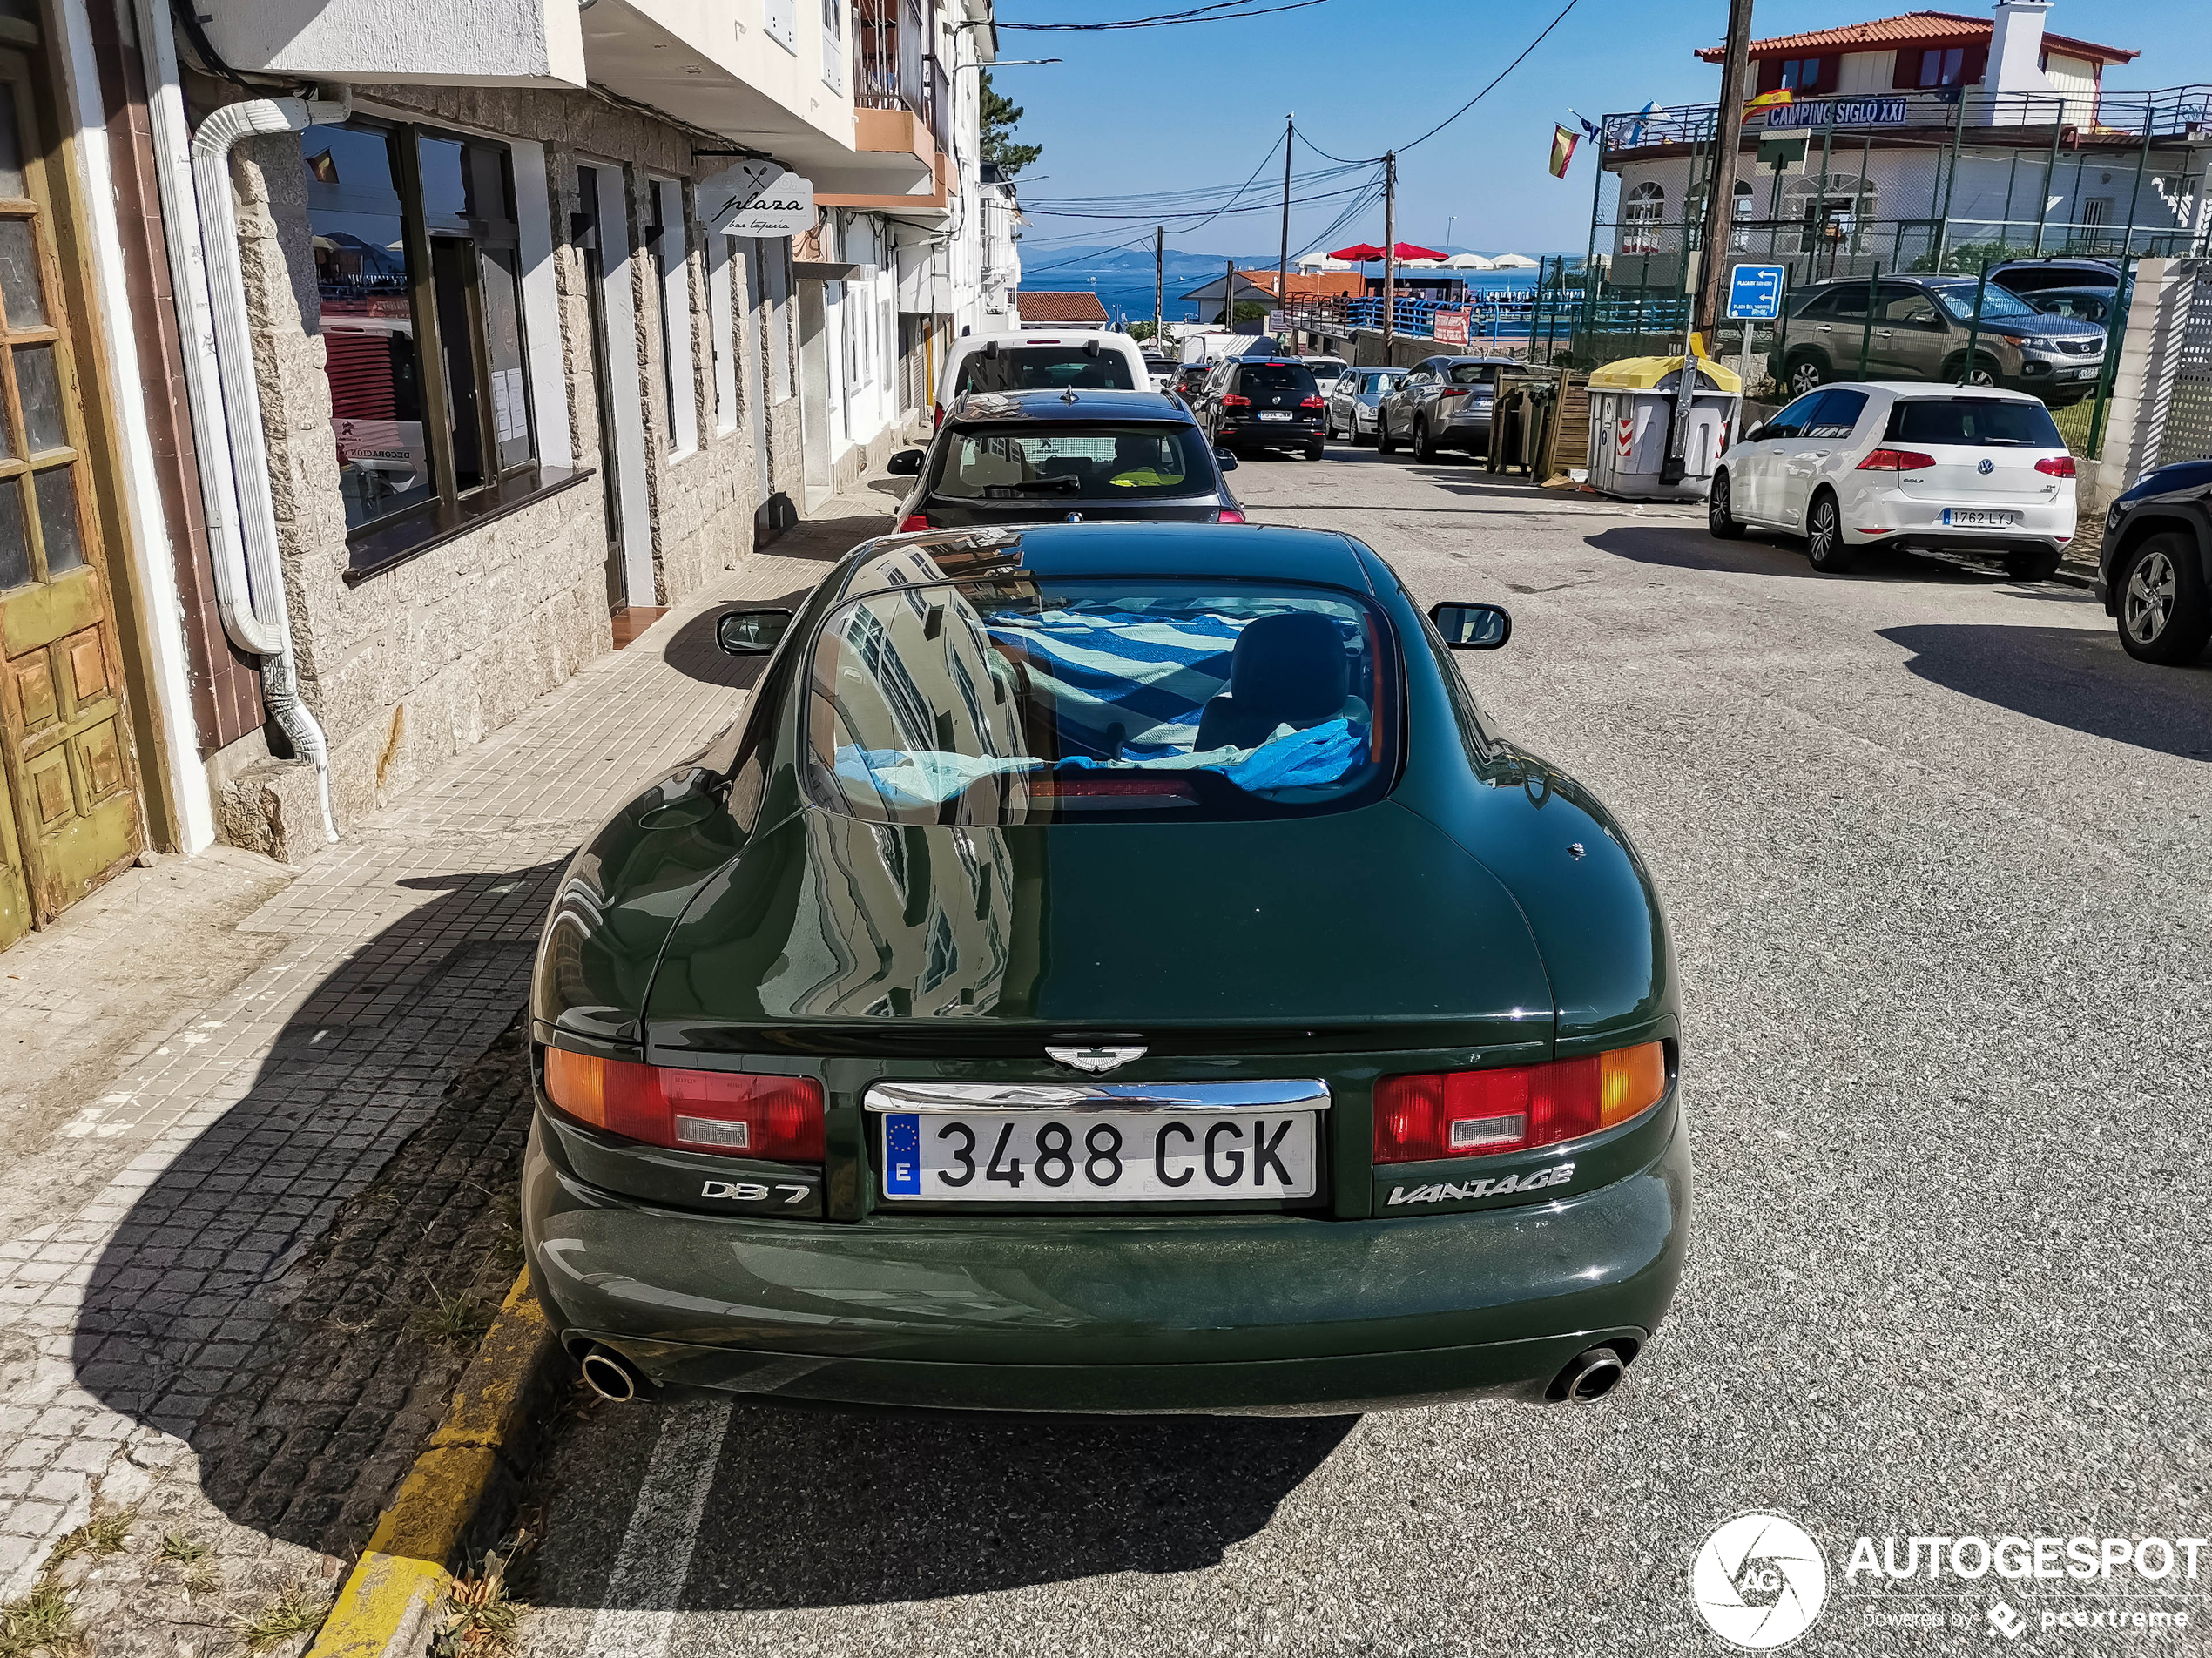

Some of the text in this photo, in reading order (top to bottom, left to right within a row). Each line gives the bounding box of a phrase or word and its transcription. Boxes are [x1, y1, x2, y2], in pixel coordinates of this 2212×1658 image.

[1836, 103, 1878, 124] SIGLO
[1879, 103, 1904, 122] XXI
[711, 191, 804, 223] plaza
[1953, 511, 2013, 525] 1762 LYJ
[936, 1120, 1294, 1188] 3488 CGK
[896, 1163, 911, 1181] E
[1387, 1163, 1576, 1205] VANTAGE
